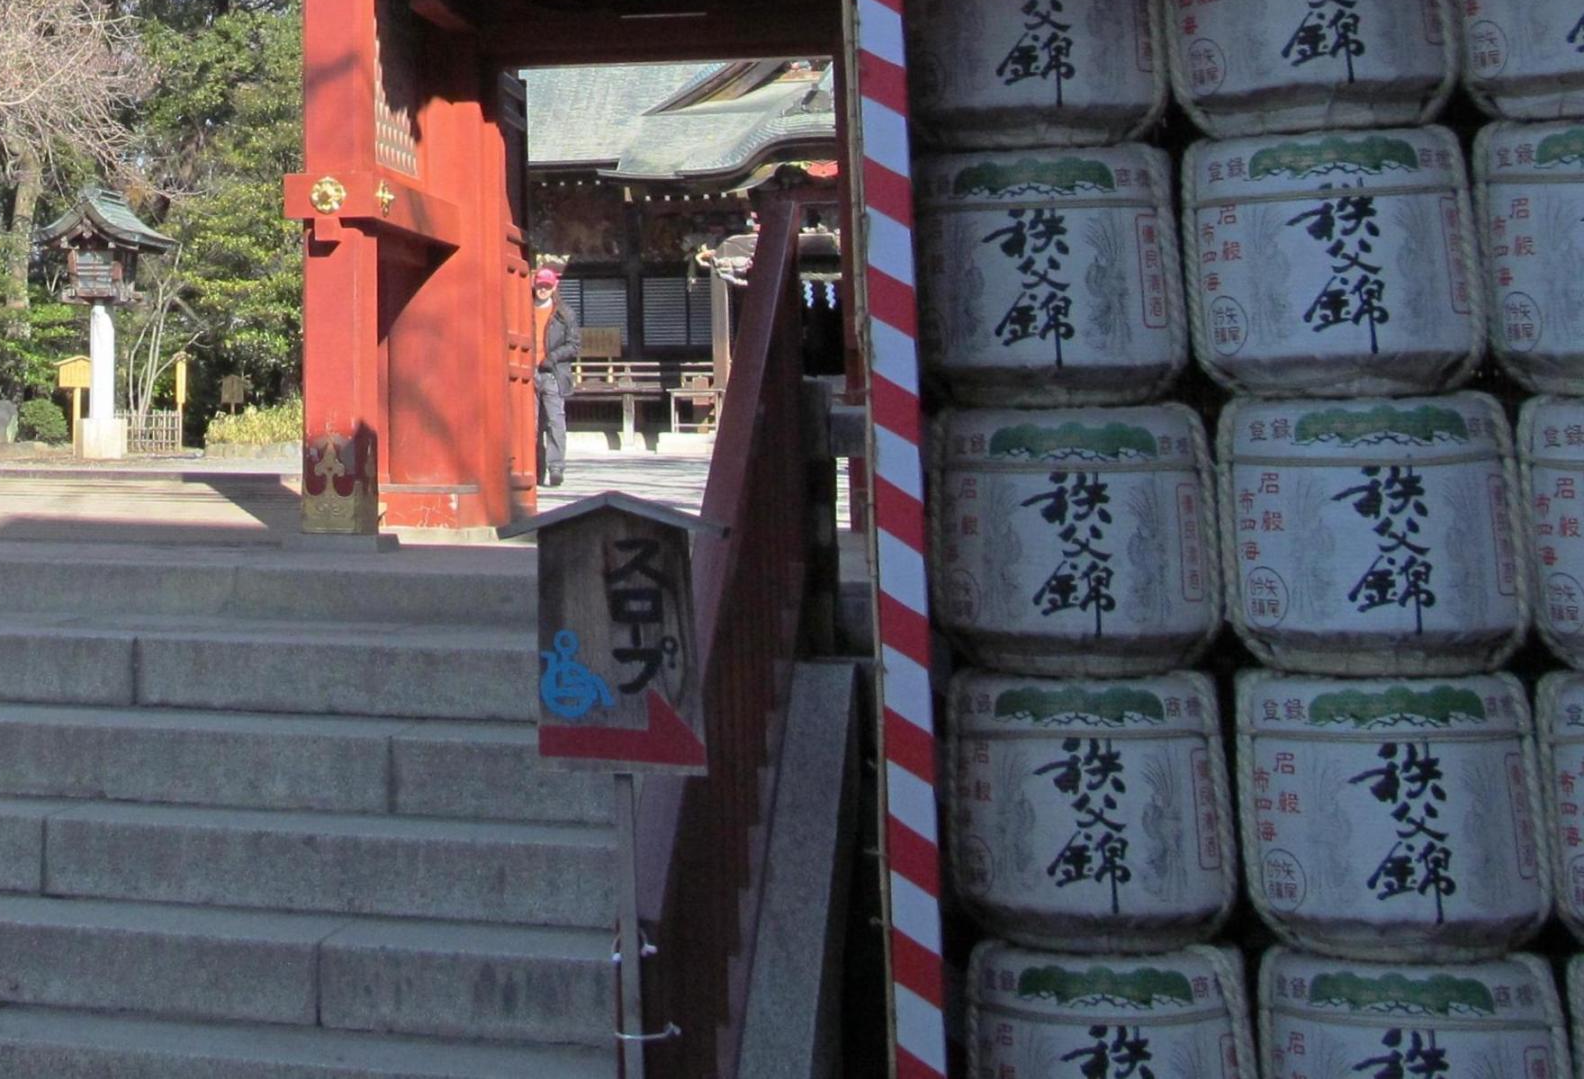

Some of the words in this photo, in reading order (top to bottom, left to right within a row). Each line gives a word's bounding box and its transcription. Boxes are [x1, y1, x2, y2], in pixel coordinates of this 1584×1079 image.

[982, 197, 1076, 370] 秩父錦
[1284, 178, 1389, 354] 秩父錦
[606, 537, 679, 695] スロープ
[1019, 470, 1117, 639] 秩父錦
[1329, 454, 1437, 636] 秩父錦
[1032, 737, 1132, 914] 秩父錦
[1346, 737, 1457, 924] 秩父錦
